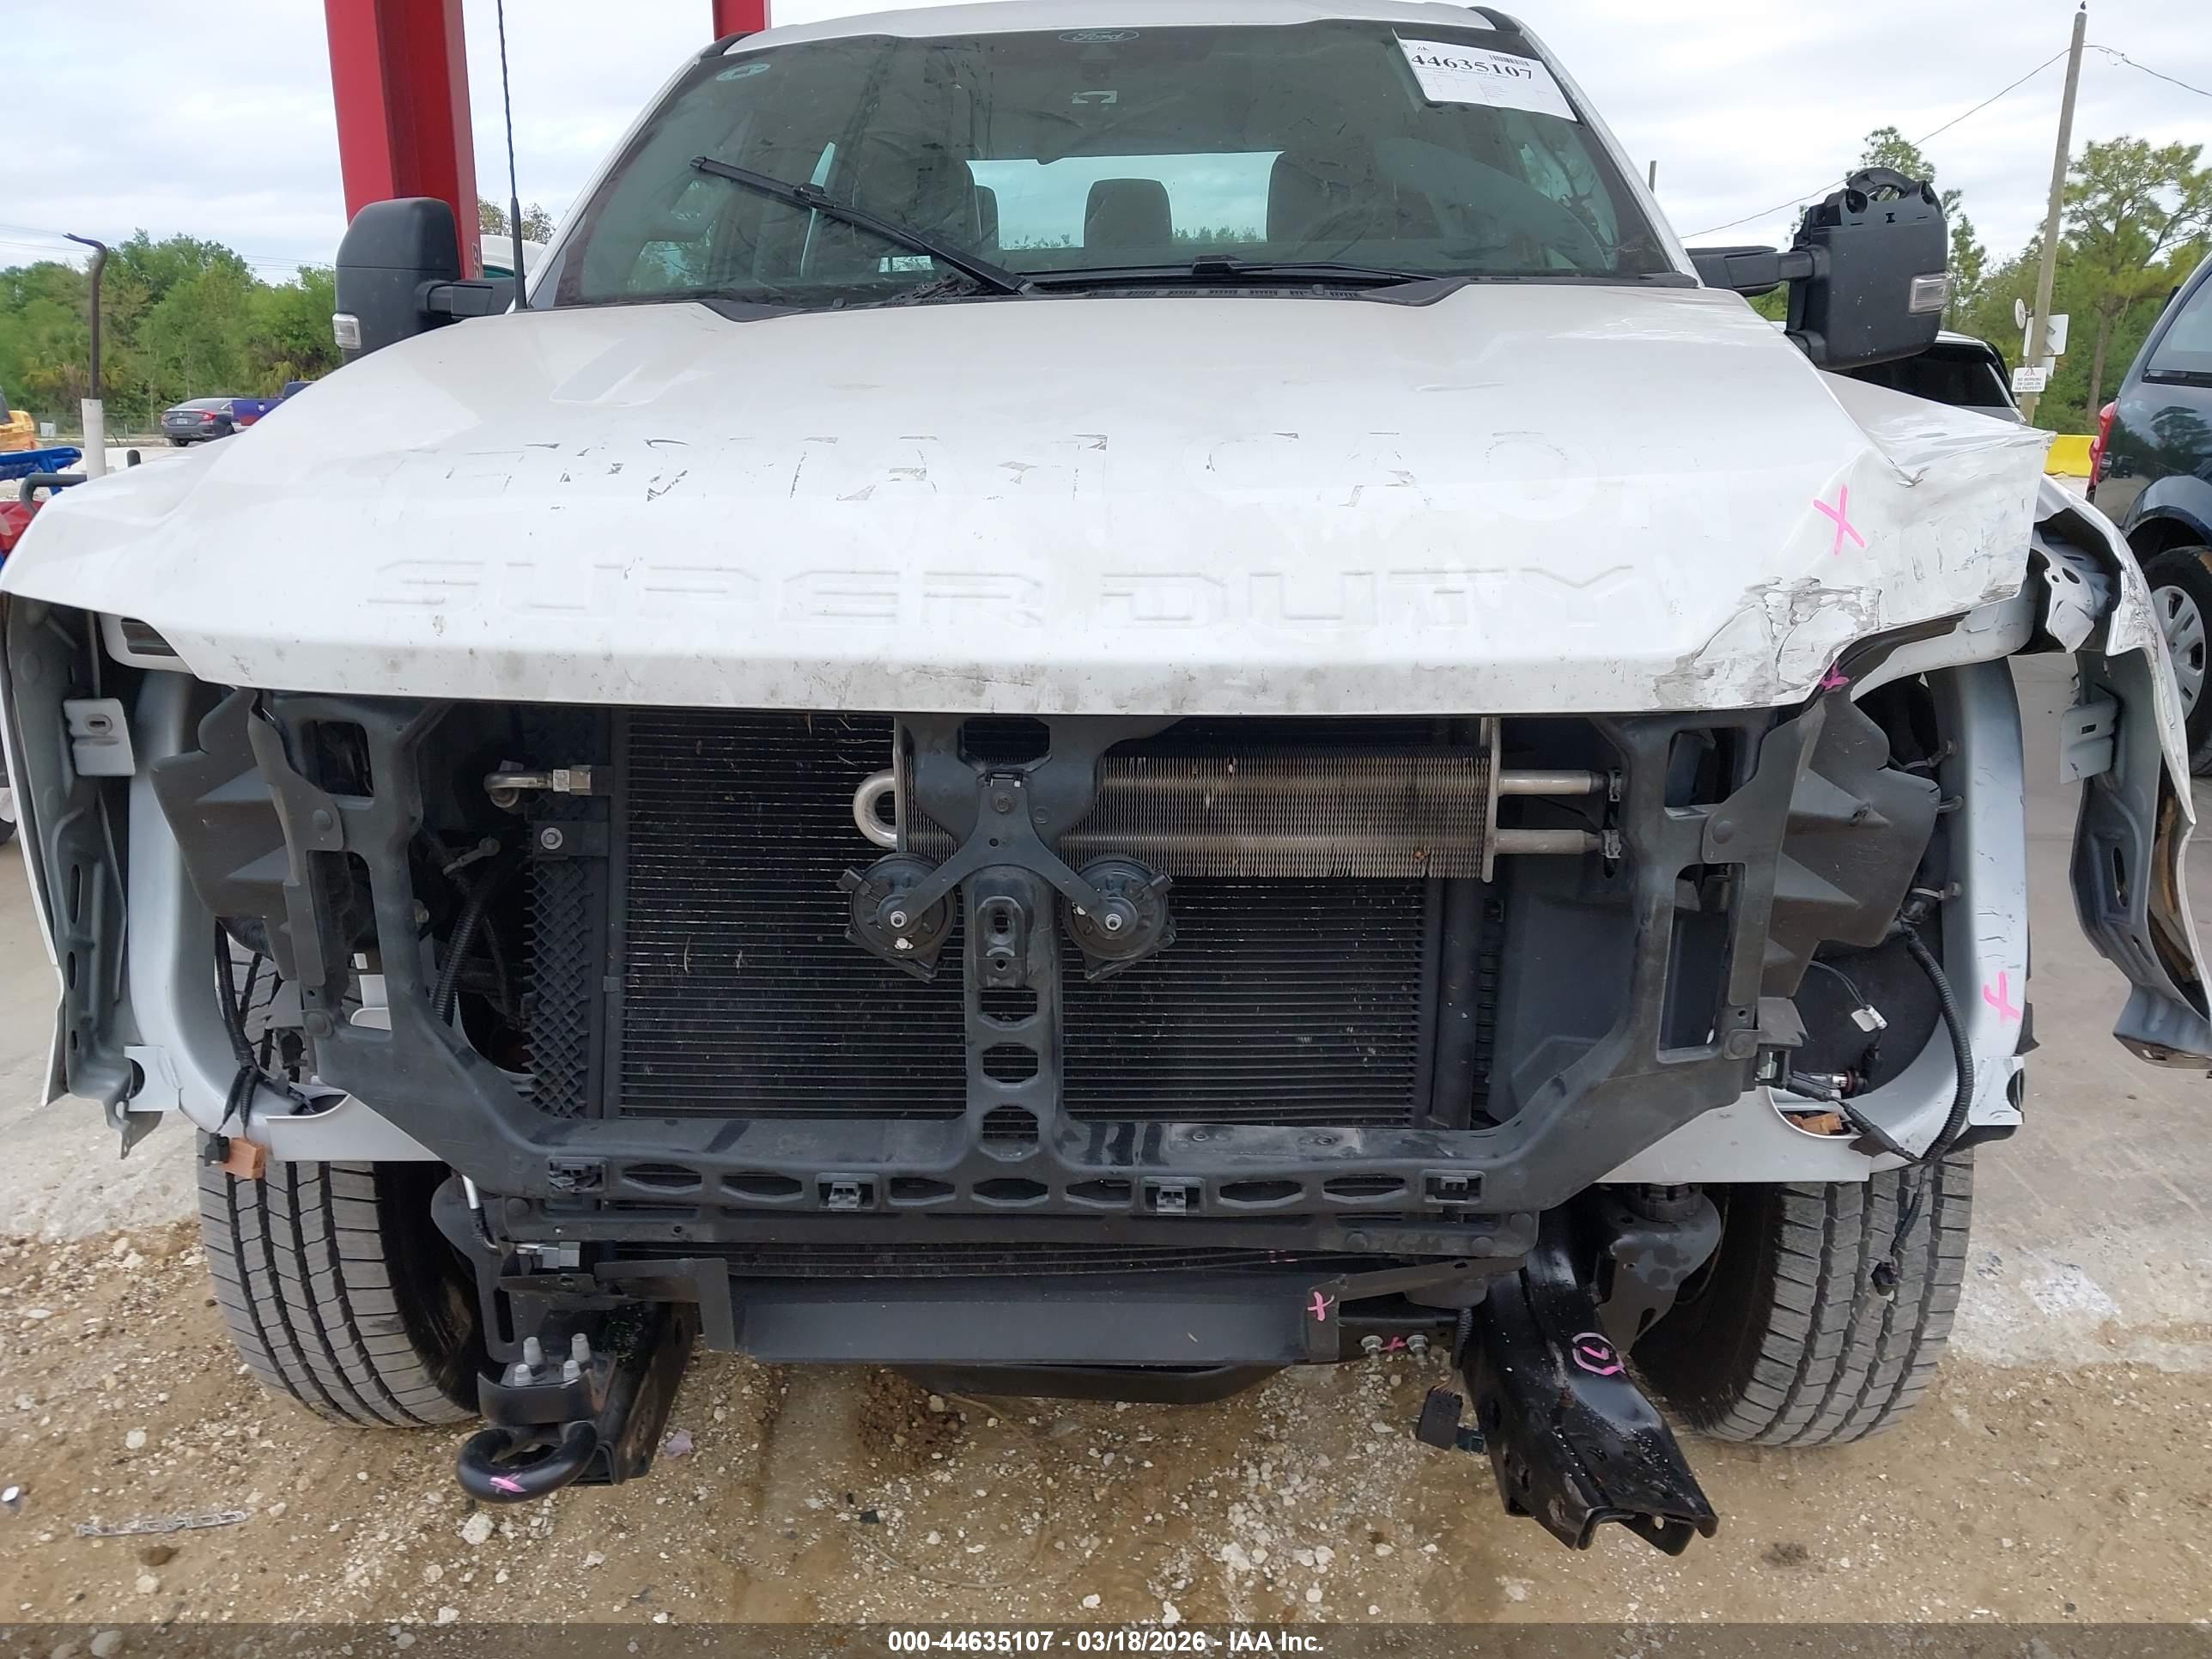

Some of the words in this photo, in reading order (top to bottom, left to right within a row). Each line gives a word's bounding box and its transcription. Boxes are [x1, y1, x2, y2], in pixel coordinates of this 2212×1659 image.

[1072, 31, 1127, 42] Ford
[1411, 53, 1533, 80] 44635107
[366, 558, 1044, 629] SUPER
[1100, 564, 1643, 629] DUTY
